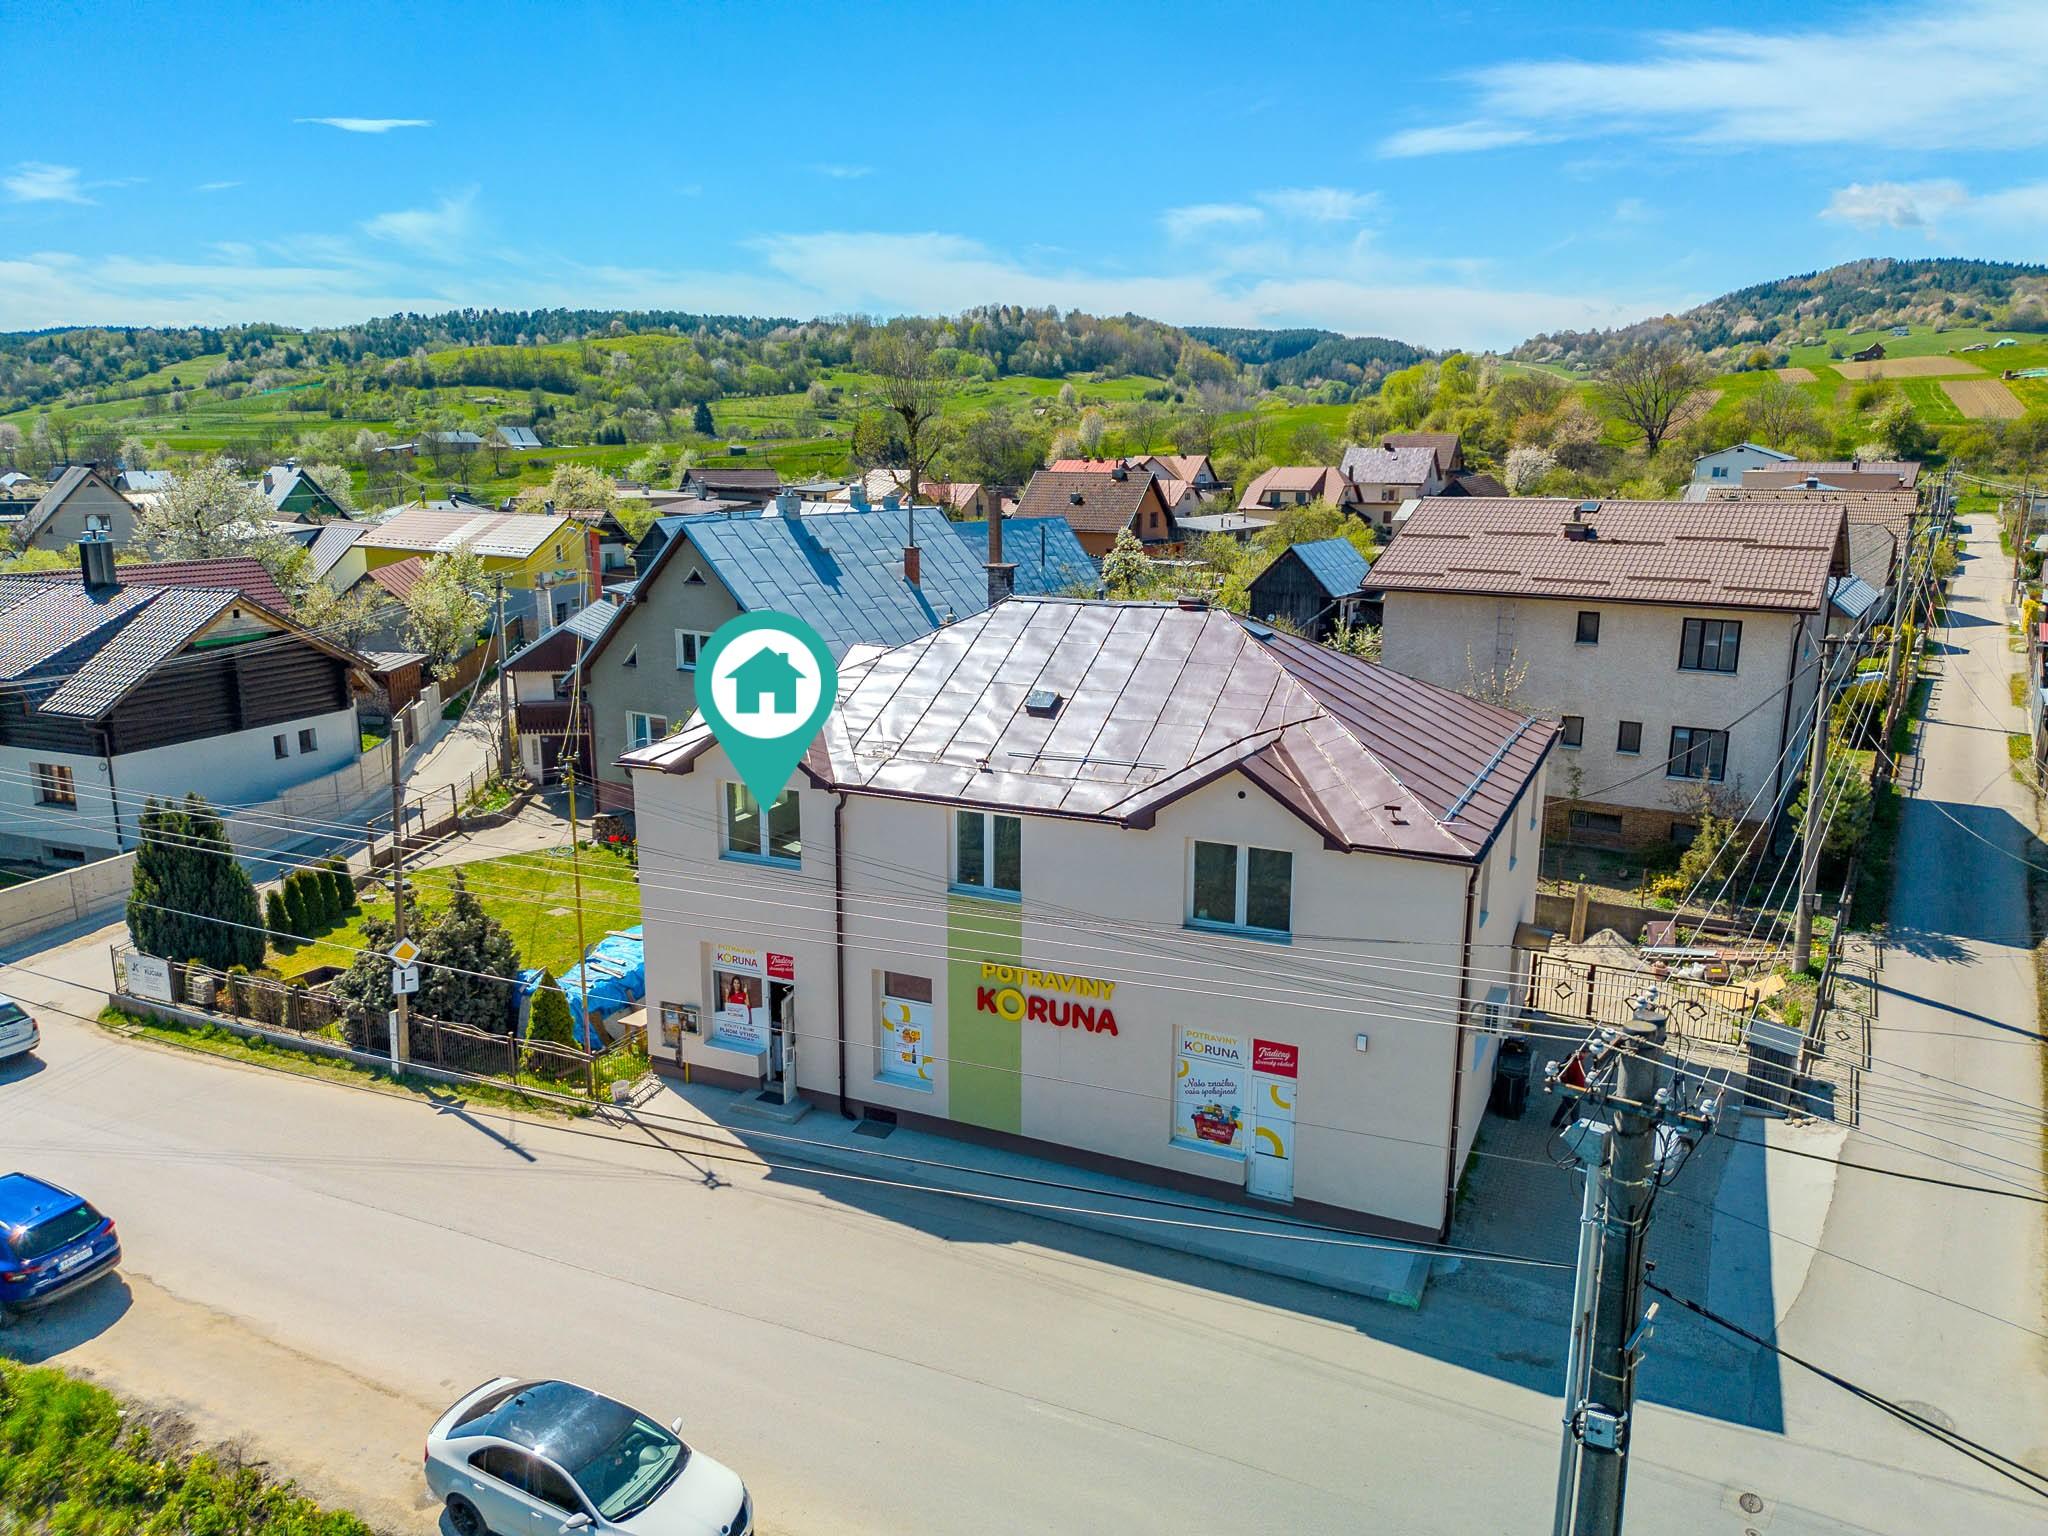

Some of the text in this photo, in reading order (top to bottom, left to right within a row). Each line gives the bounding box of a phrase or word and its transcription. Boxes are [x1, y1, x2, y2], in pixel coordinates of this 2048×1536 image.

[717, 952, 758, 968] KORUNA
[981, 962, 1116, 1000] POTRAVINY
[976, 986, 1119, 1037] KORUNA
[1186, 1030, 1238, 1046] POTRAVINY
[1184, 1040, 1239, 1060] KORUNA
